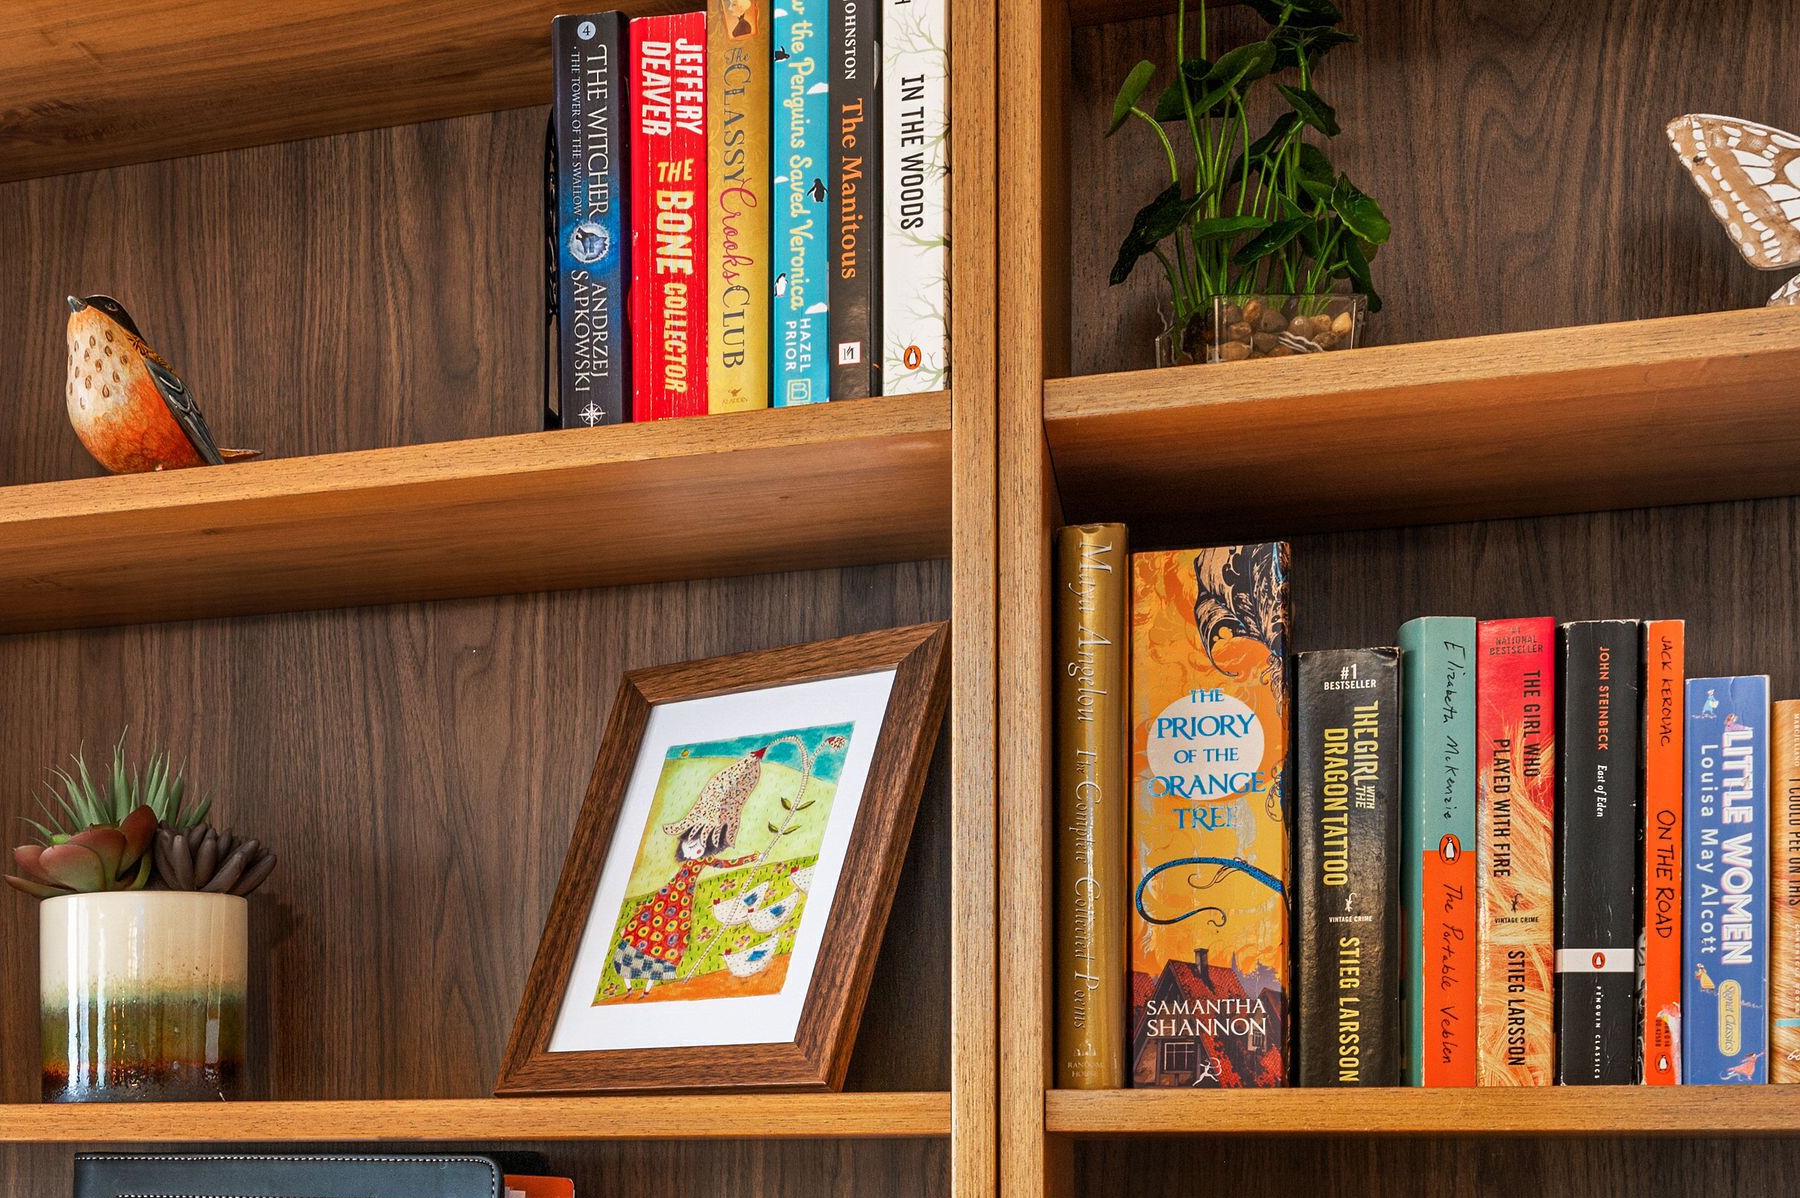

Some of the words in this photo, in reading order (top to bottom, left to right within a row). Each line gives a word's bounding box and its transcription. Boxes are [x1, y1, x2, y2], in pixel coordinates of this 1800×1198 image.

[571, 53, 580, 75] THE
[844, 0, 856, 80] OHNSTON
[571, 78, 580, 113] TOWER
[587, 44, 607, 111] THE
[641, 41, 671, 136] DEAVER
[675, 38, 702, 135] JEFFERY
[902, 74, 924, 101] IN
[572, 116, 580, 133] OF
[572, 136, 581, 159] THE
[841, 98, 863, 148] The
[901, 107, 924, 147] THE
[572, 161, 582, 216] SWALLOW
[587, 116, 609, 217] WITCHER
[658, 159, 694, 182] THE
[901, 152, 924, 230] WOODS
[656, 190, 693, 275] BONE
[841, 155, 863, 279] Manitous
[571, 270, 590, 391] SAPKOWSKI
[591, 283, 608, 378] ANDRZEJ
[663, 284, 688, 393] COLLECTOR
[786, 321, 796, 371] PRIOR
[801, 318, 811, 373] HAZEL
[1599, 646, 1609, 681] JOHN
[1191, 688, 1224, 702] THE
[1598, 686, 1609, 751] STEINBECK
[1157, 714, 1256, 739] PRIORY
[1174, 748, 1198, 763] OF
[1204, 748, 1239, 762] THE
[1596, 764, 1607, 788] East
[1700, 743, 1719, 817] Louisa
[1721, 730, 1754, 825] LITTLE
[1148, 771, 1266, 798] ORANGE
[1596, 789, 1606, 797] of
[1596, 798, 1604, 818] Eden
[1173, 807, 1238, 831] TREE
[1696, 828, 1718, 874] May
[1700, 882, 1718, 954] Alcott
[1719, 832, 1754, 966] WOMEN
[1338, 937, 1360, 988] STIEG
[1147, 999, 1266, 1017] SAMANTHA
[1147, 1018, 1267, 1037] SHANNON
[1594, 985, 1602, 1030] PENGUIN
[1338, 997, 1360, 1082] LARSSON
